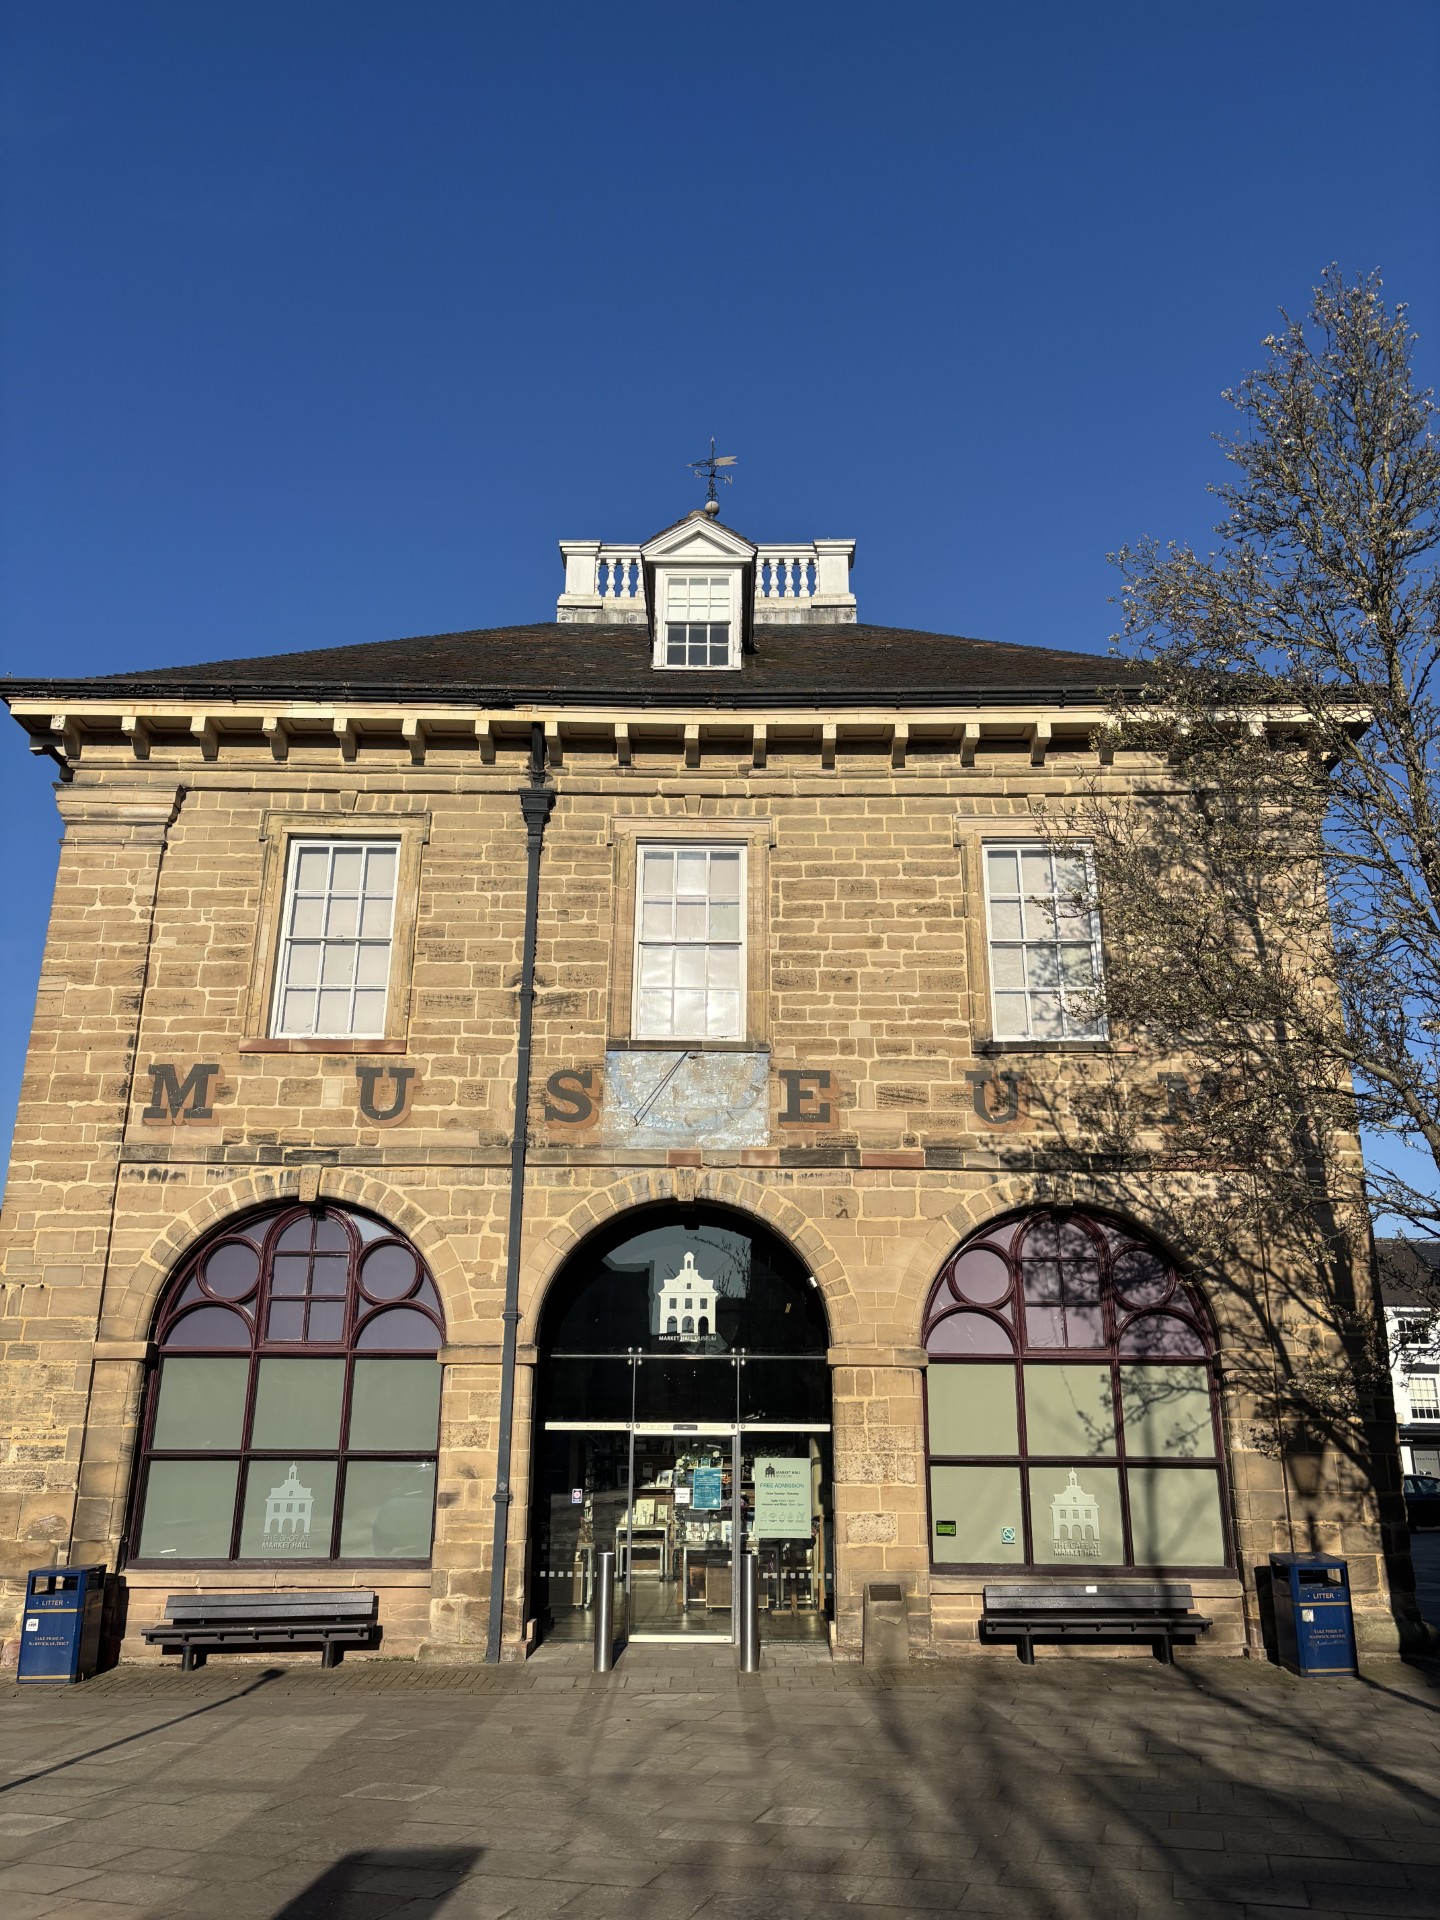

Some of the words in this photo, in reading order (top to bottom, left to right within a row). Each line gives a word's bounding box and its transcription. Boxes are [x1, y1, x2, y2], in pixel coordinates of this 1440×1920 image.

[1053, 1541, 1068, 1549] THE
[1091, 1541, 1100, 1549] AT
[1054, 1549, 1081, 1557] MARKET
[1084, 1549, 1101, 1557] HALL
